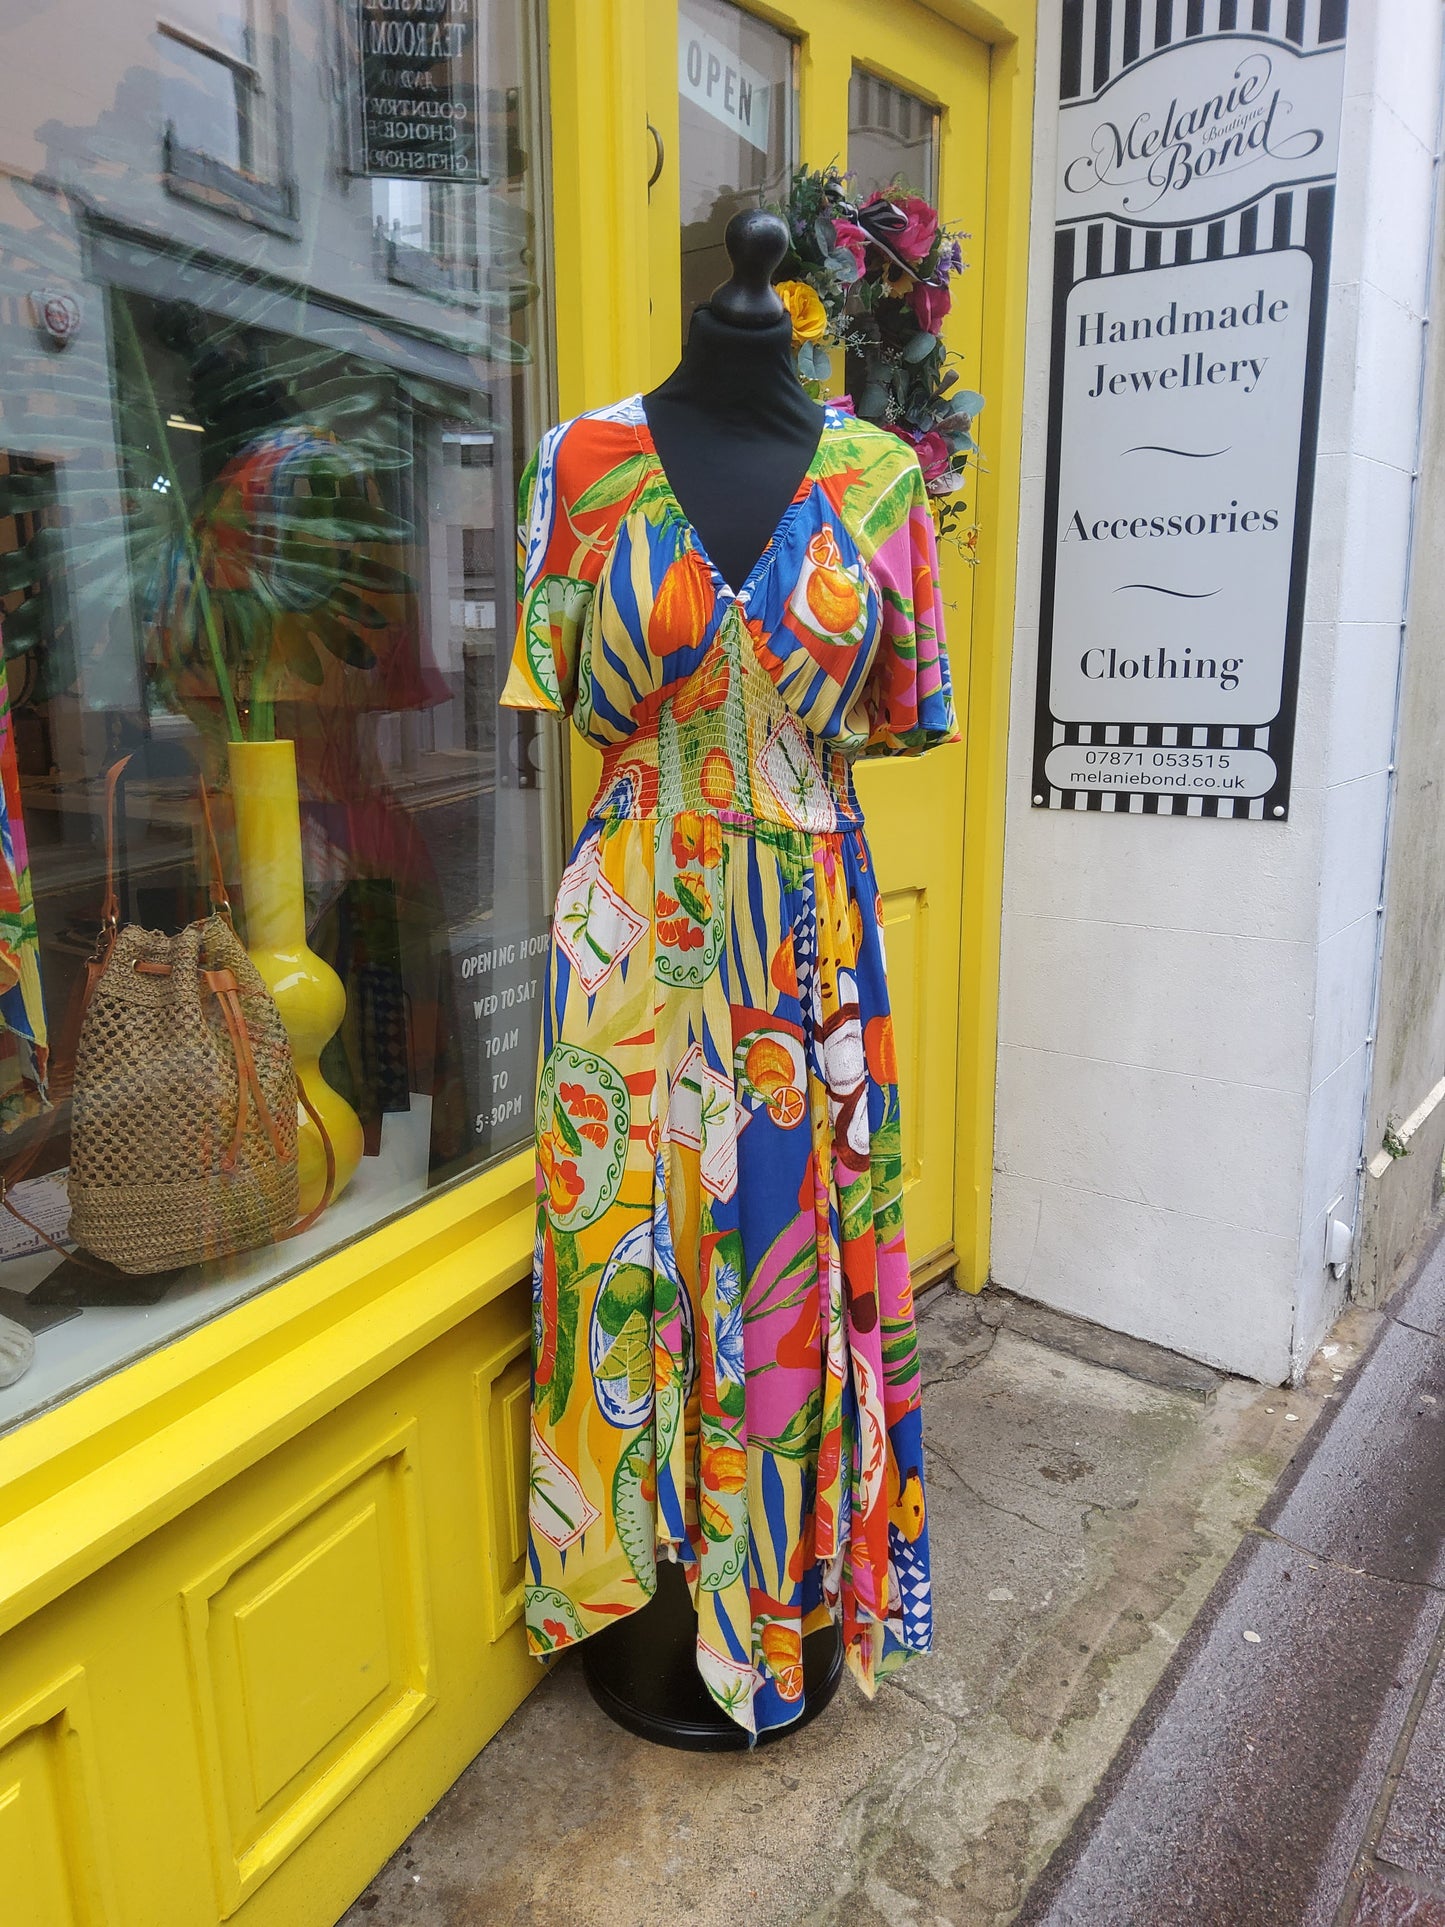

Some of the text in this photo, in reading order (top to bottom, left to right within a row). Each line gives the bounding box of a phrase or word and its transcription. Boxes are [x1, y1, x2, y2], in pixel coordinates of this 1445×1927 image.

[687, 39, 752, 127] OPEN
[1064, 54, 1272, 193] Melanie
[1202, 106, 1265, 145] Boutique
[1123, 89, 1324, 213] Bond
[1076, 289, 1289, 347] Handmade
[1088, 352, 1270, 397] Jewellery
[1061, 500, 1279, 542] Accessories
[1080, 647, 1243, 690] Clothing
[1070, 770, 1245, 789] melaniebond.co.uk
[1085, 751, 1230, 769] 07871 053515
[461, 944, 515, 979] OPENING
[473, 980, 538, 1020] WED TO SAT
[492, 1071, 508, 1094] TO
[475, 1095, 522, 1134] 5:30PM
